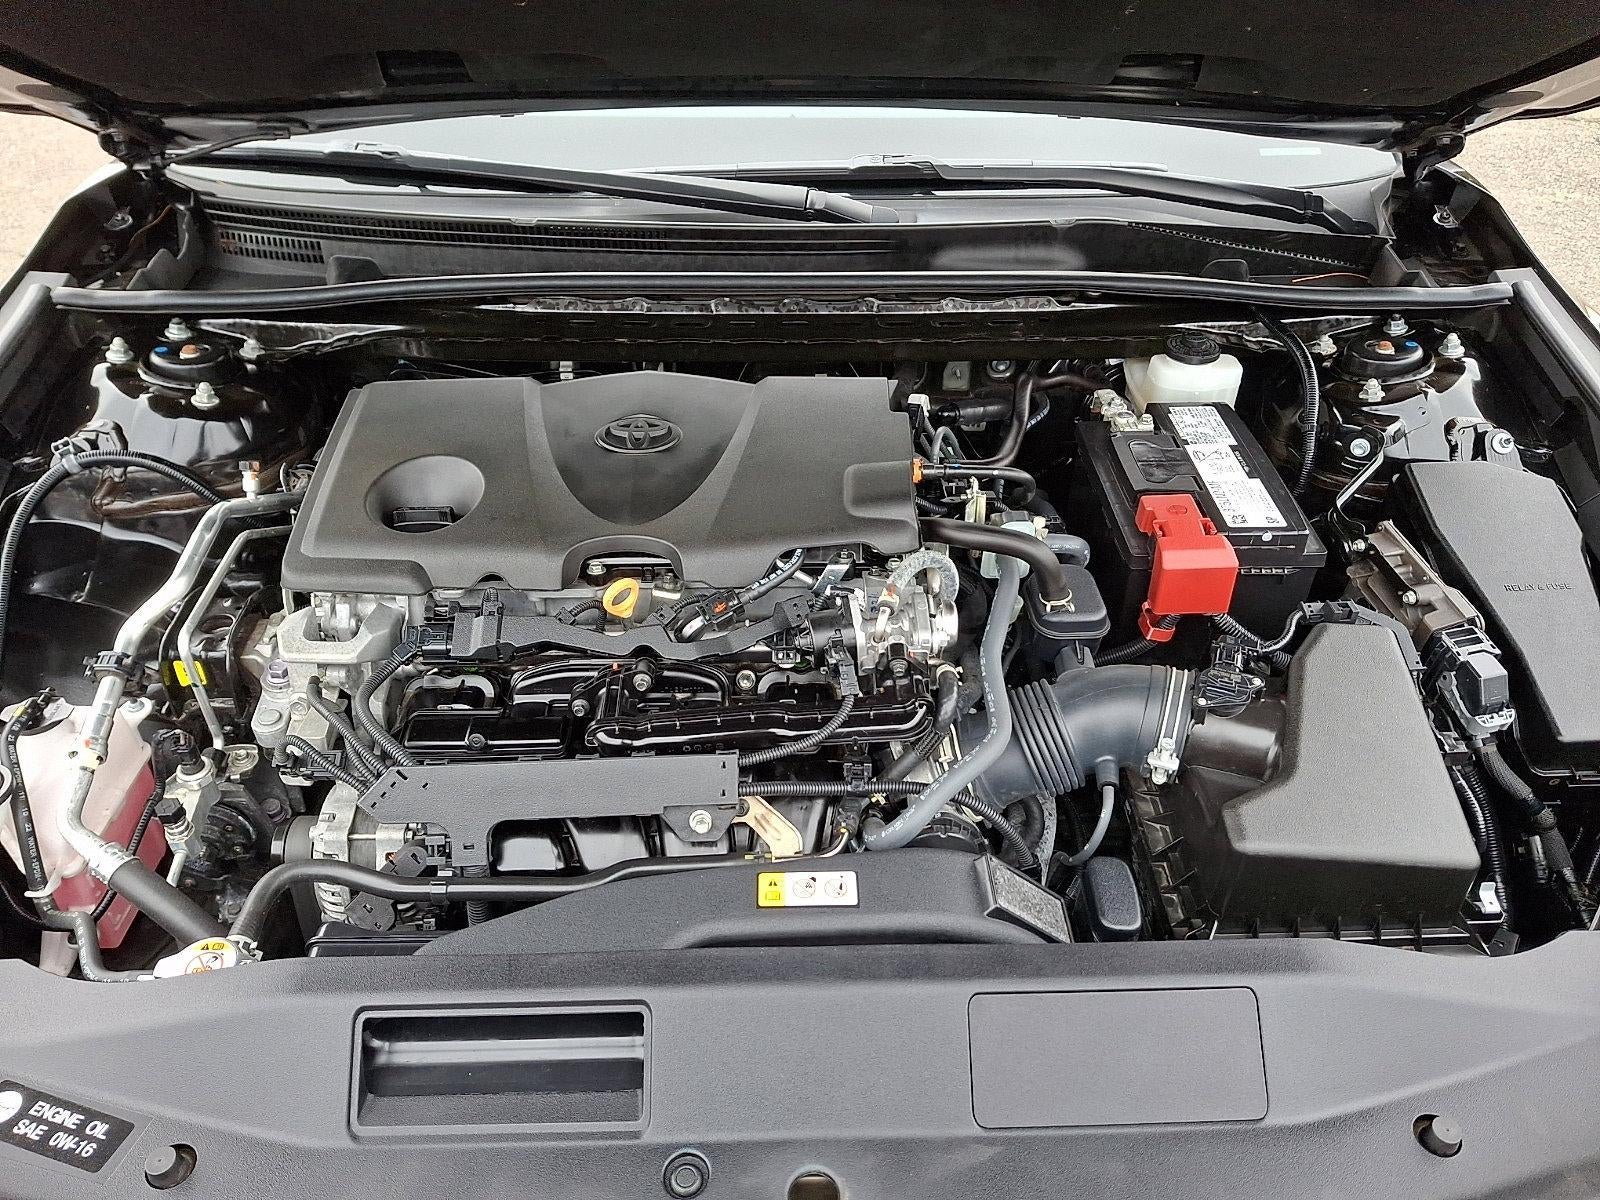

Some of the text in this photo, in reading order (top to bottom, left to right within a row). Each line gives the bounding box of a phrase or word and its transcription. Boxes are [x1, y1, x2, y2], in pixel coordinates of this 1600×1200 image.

[1503, 583, 1535, 592] RELAY
[1546, 582, 1573, 590] FUSE
[27, 836, 38, 858] WATER
[28, 1101, 112, 1140] ENGINE OIL
[12, 1119, 97, 1158] SAE 0W-16
